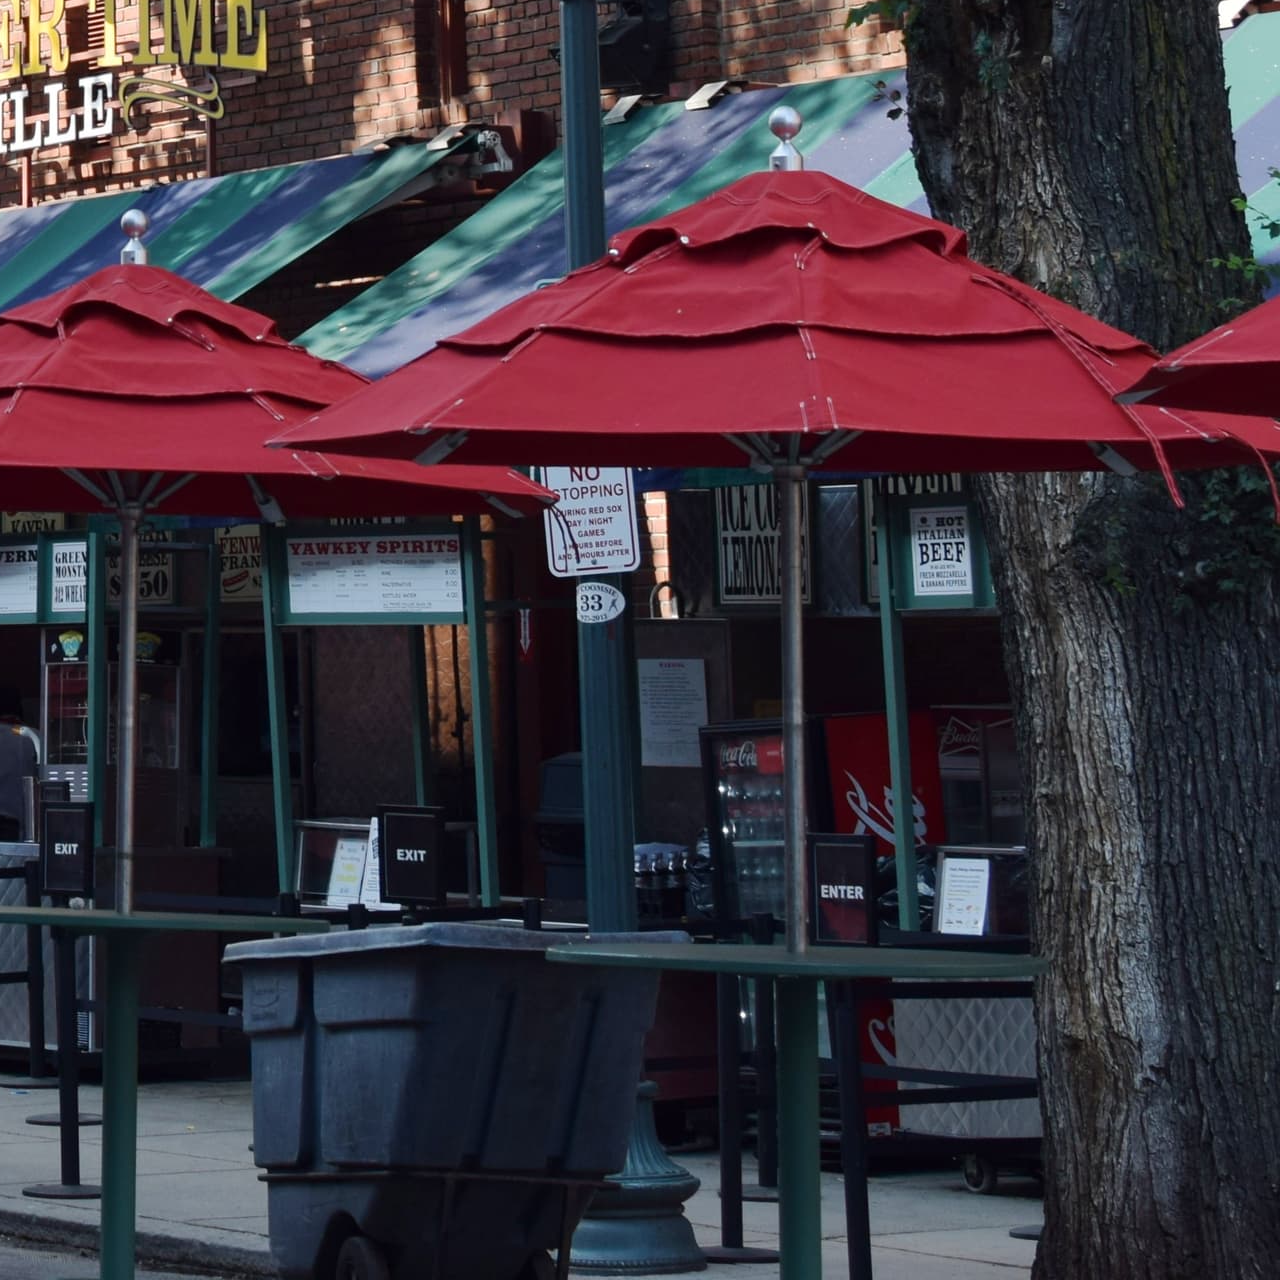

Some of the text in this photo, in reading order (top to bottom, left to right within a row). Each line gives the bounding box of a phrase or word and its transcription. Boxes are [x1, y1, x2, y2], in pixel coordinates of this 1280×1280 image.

[569, 467, 600, 482] NO
[588, 506, 605, 515] RED
[606, 504, 623, 513] SOX
[567, 520, 582, 528] DAY
[588, 516, 614, 526] NIGHT
[935, 516, 964, 527] HOT
[577, 528, 606, 538] GAMES
[918, 528, 965, 540] ITALIAN
[220, 535, 260, 555] FENW
[289, 538, 458, 555] YAWKEY SPIRITS
[595, 539, 624, 548] BEFORE
[580, 550, 606, 559] HOURS
[606, 548, 630, 557] AFTER
[918, 541, 966, 566] BEEF
[580, 593, 603, 612] 33
[53, 843, 79, 856] EXIT
[396, 848, 427, 862] EXIT
[820, 884, 865, 900] ENTER
